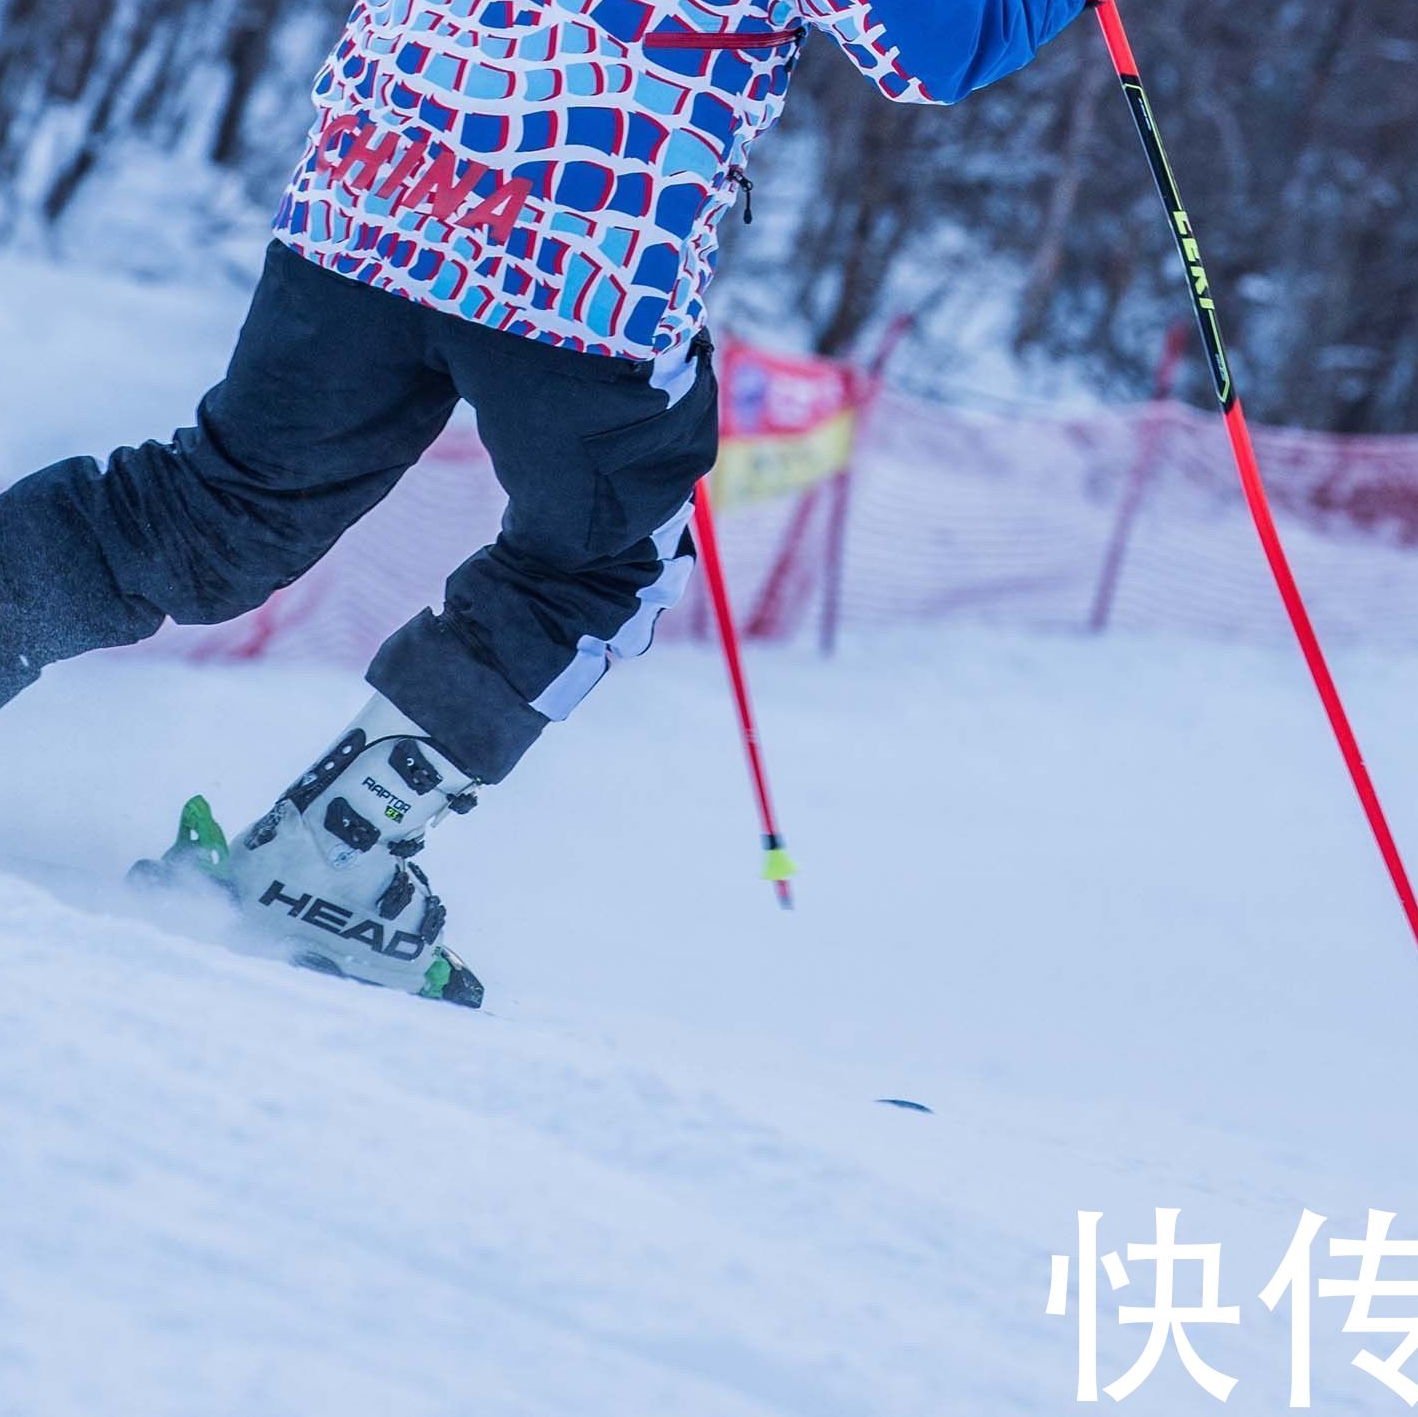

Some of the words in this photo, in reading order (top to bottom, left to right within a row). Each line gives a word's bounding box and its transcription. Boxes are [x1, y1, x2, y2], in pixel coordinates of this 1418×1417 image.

[314, 114, 534, 247] CHINA
[1172, 210, 1216, 310] LEKI
[361, 776, 412, 814] RAPTOR
[258, 879, 425, 961] HEAD
